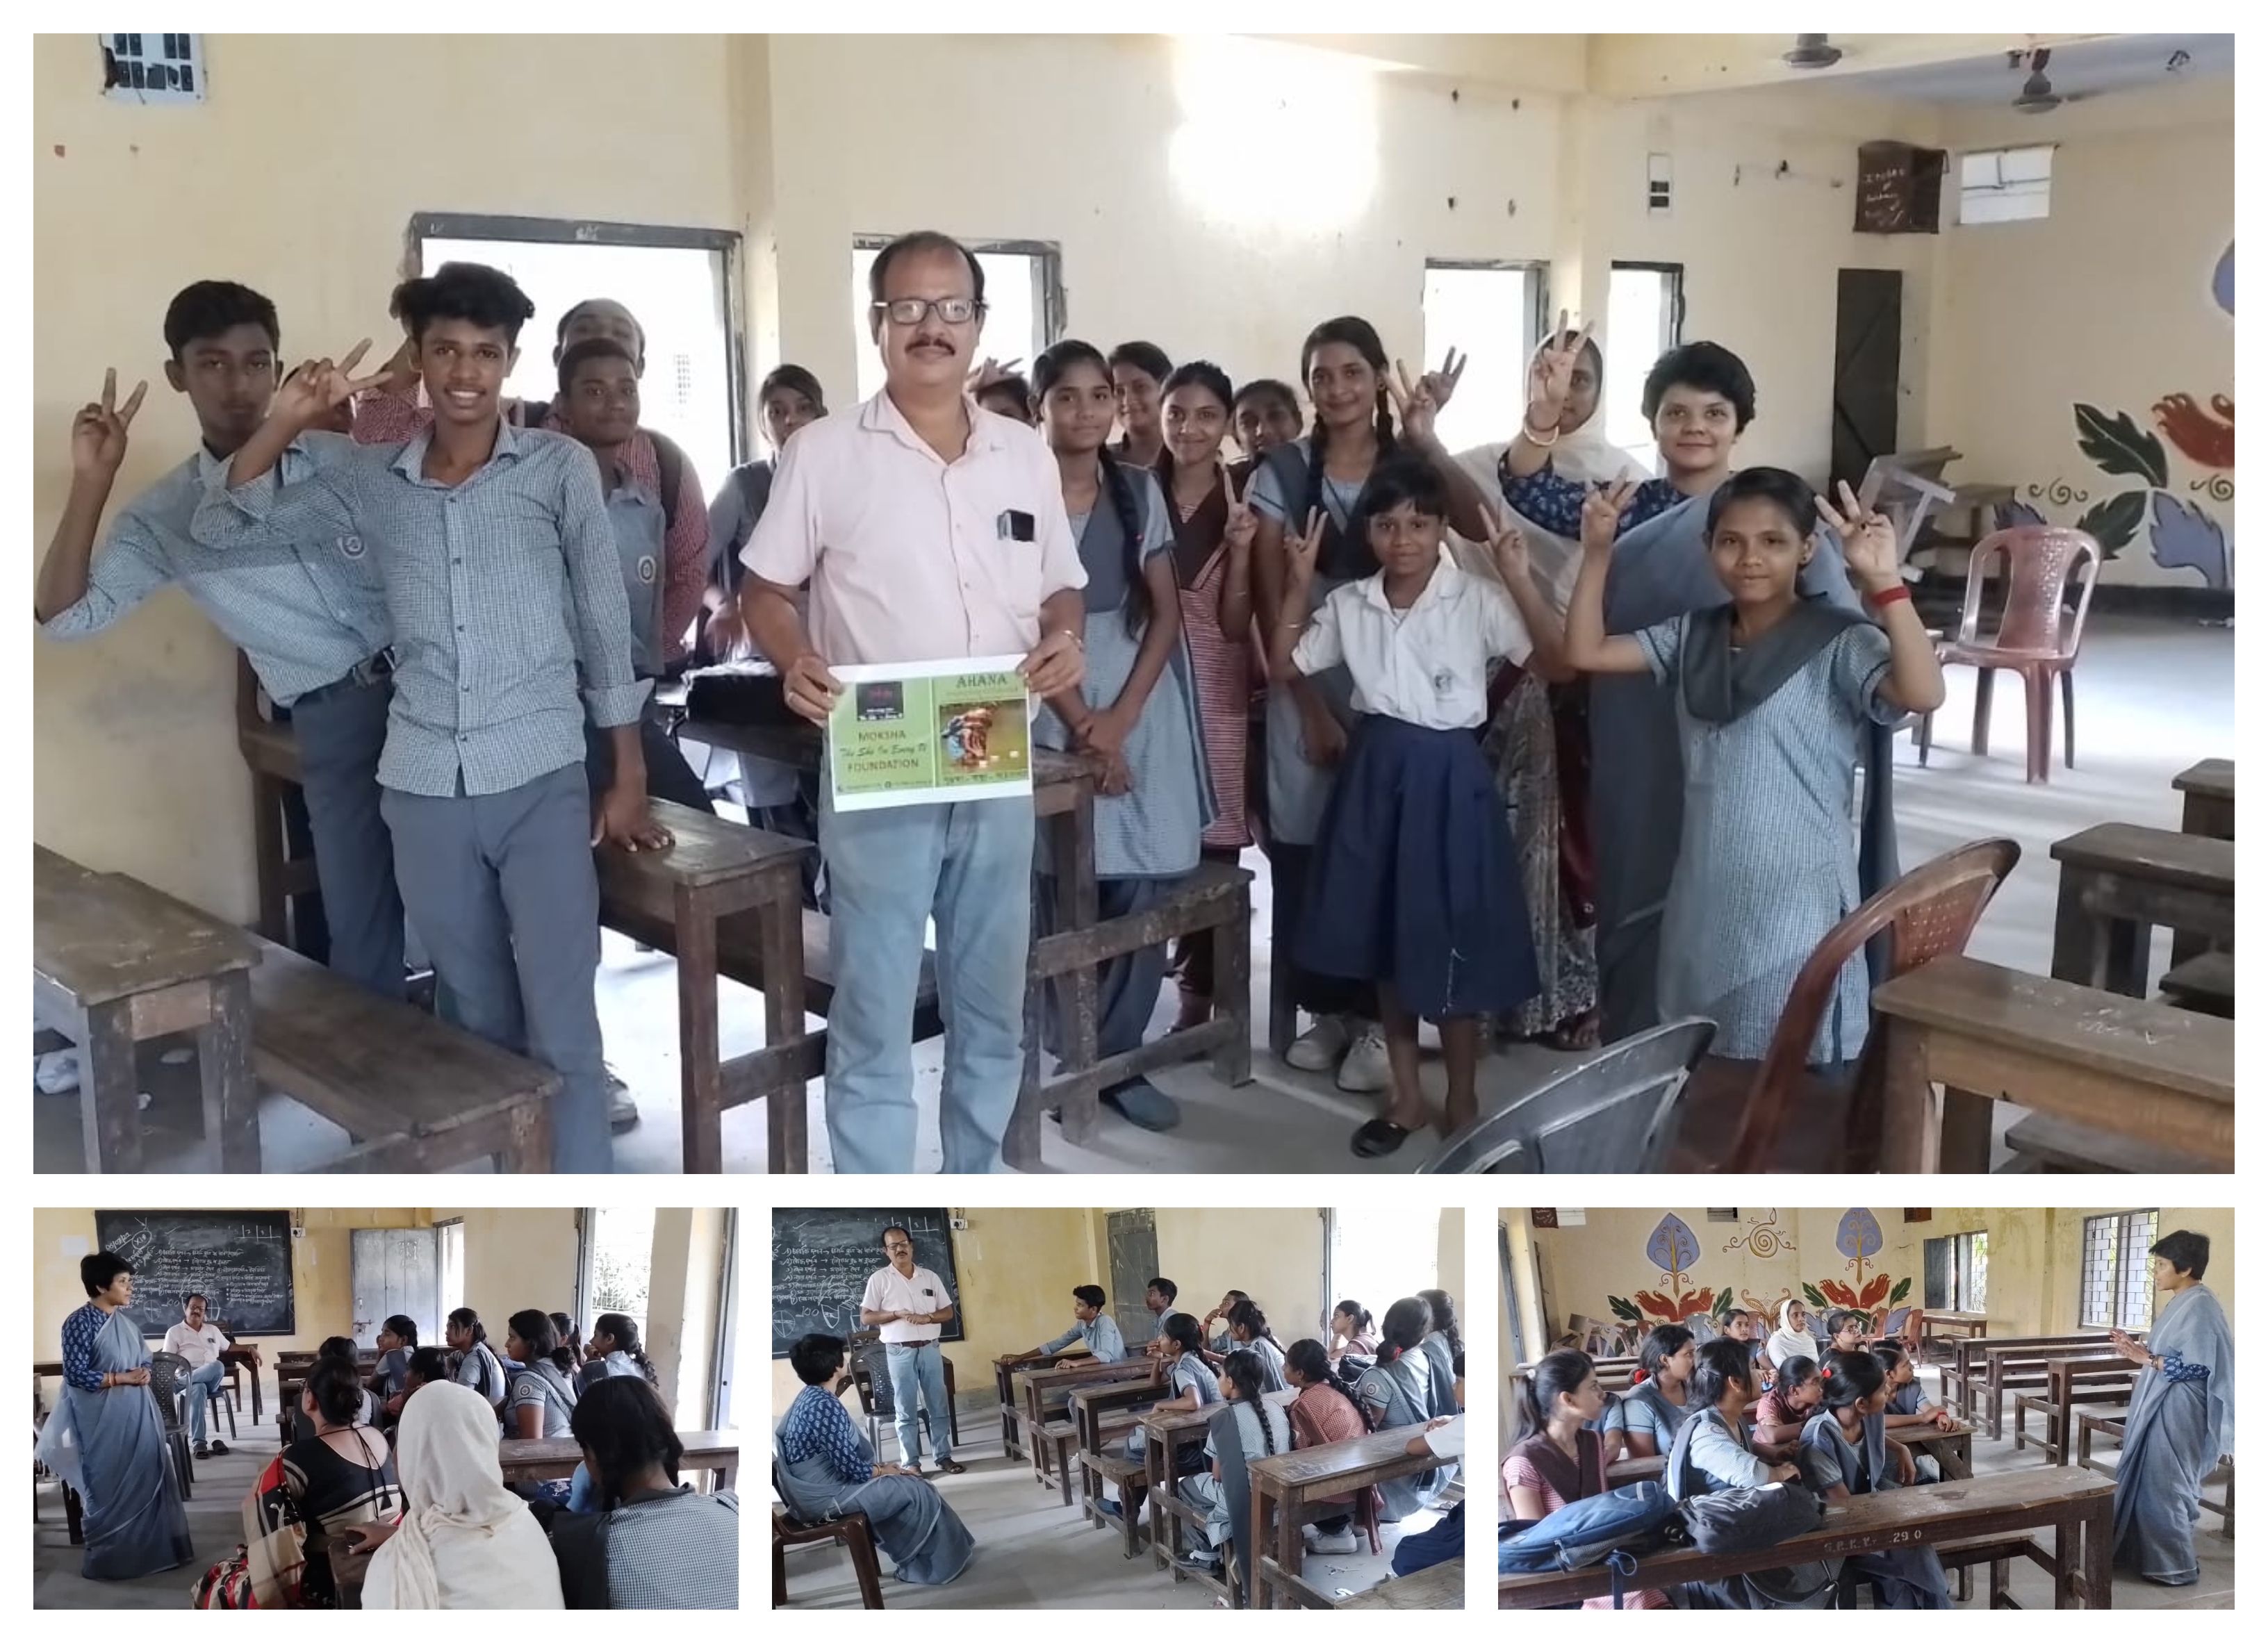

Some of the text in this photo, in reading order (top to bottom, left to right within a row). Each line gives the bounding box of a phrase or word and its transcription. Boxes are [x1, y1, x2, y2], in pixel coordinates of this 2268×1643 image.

[956, 673, 1007, 688] AHANA
[858, 730, 906, 743] MOKSHA
[848, 759, 919, 772] FOUNDATION
